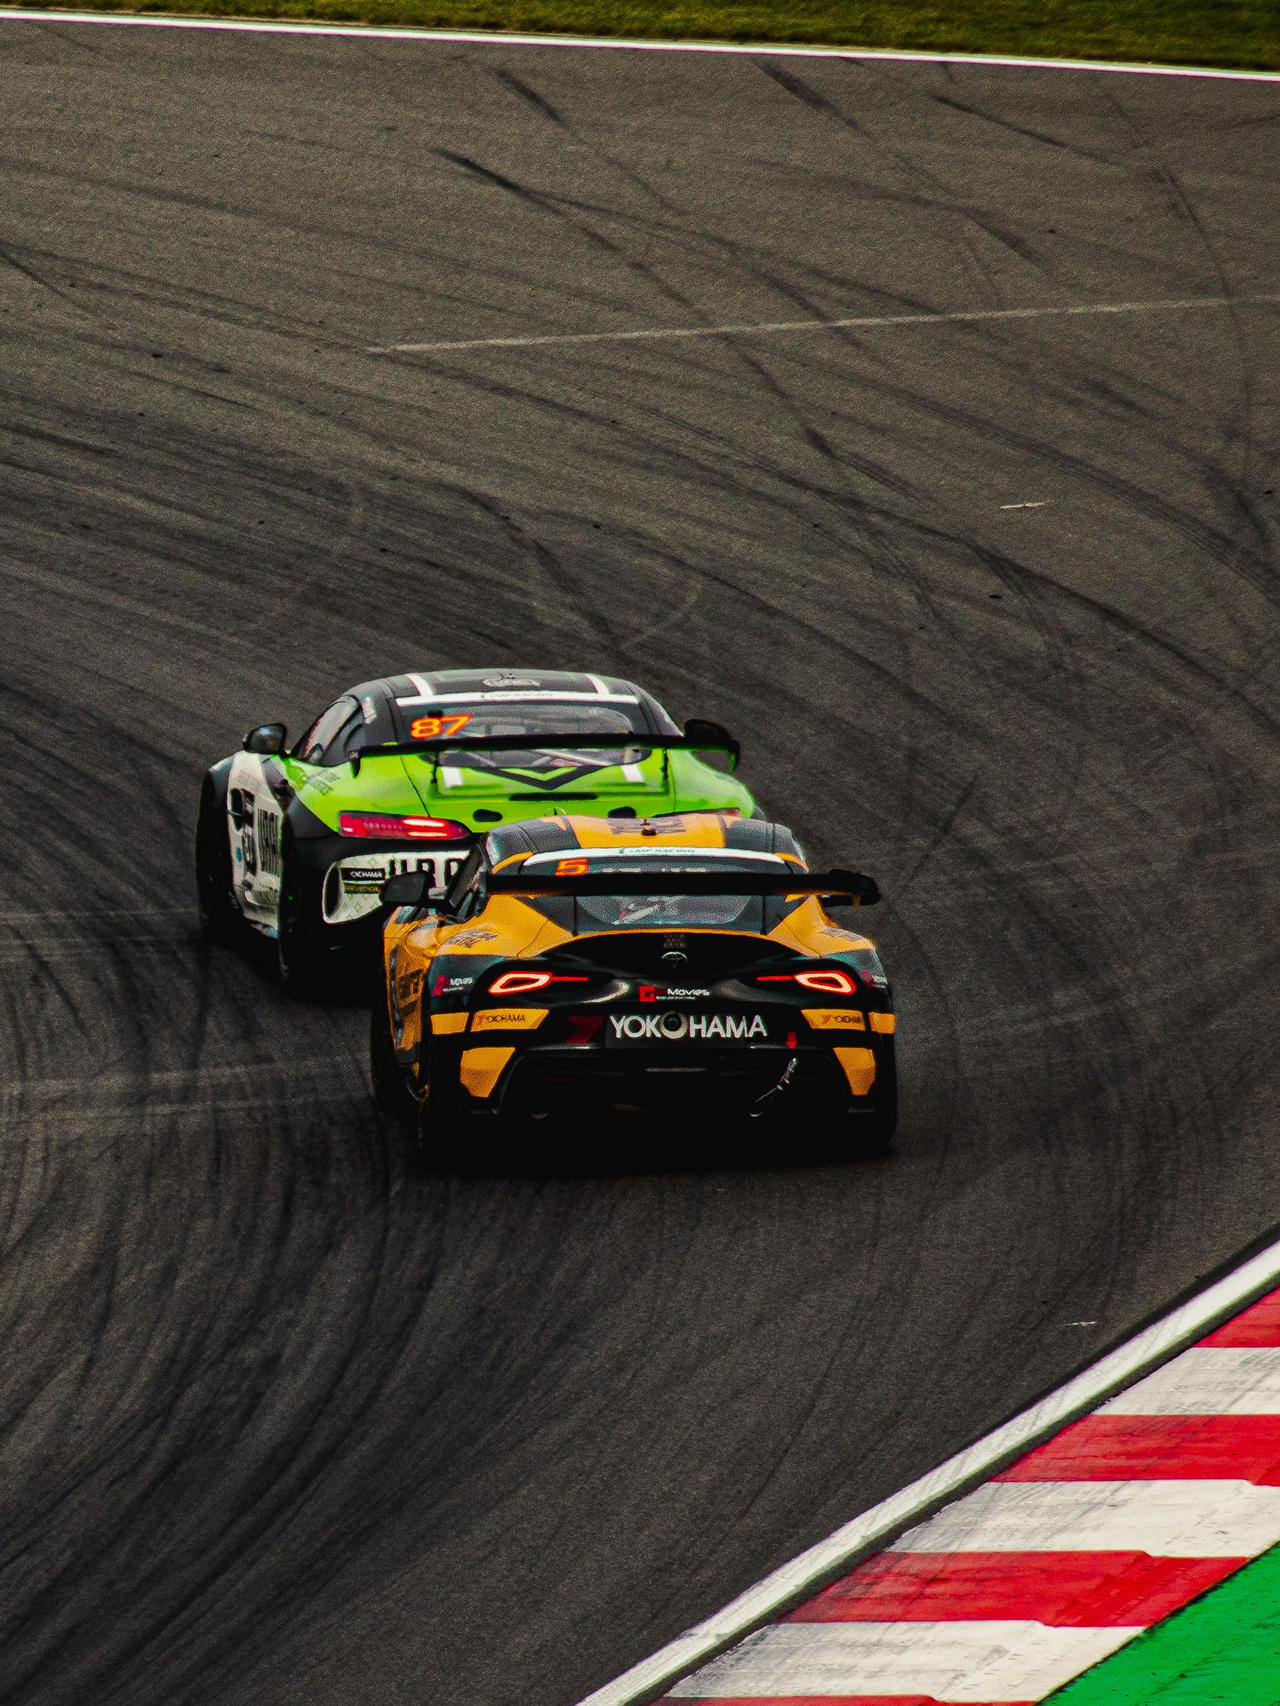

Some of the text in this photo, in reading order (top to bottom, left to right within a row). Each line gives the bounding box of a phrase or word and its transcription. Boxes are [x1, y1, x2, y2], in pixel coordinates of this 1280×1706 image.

[410, 713, 474, 739] 87
[554, 858, 590, 877] 5
[610, 1011, 768, 1040] YOKOHAMA
